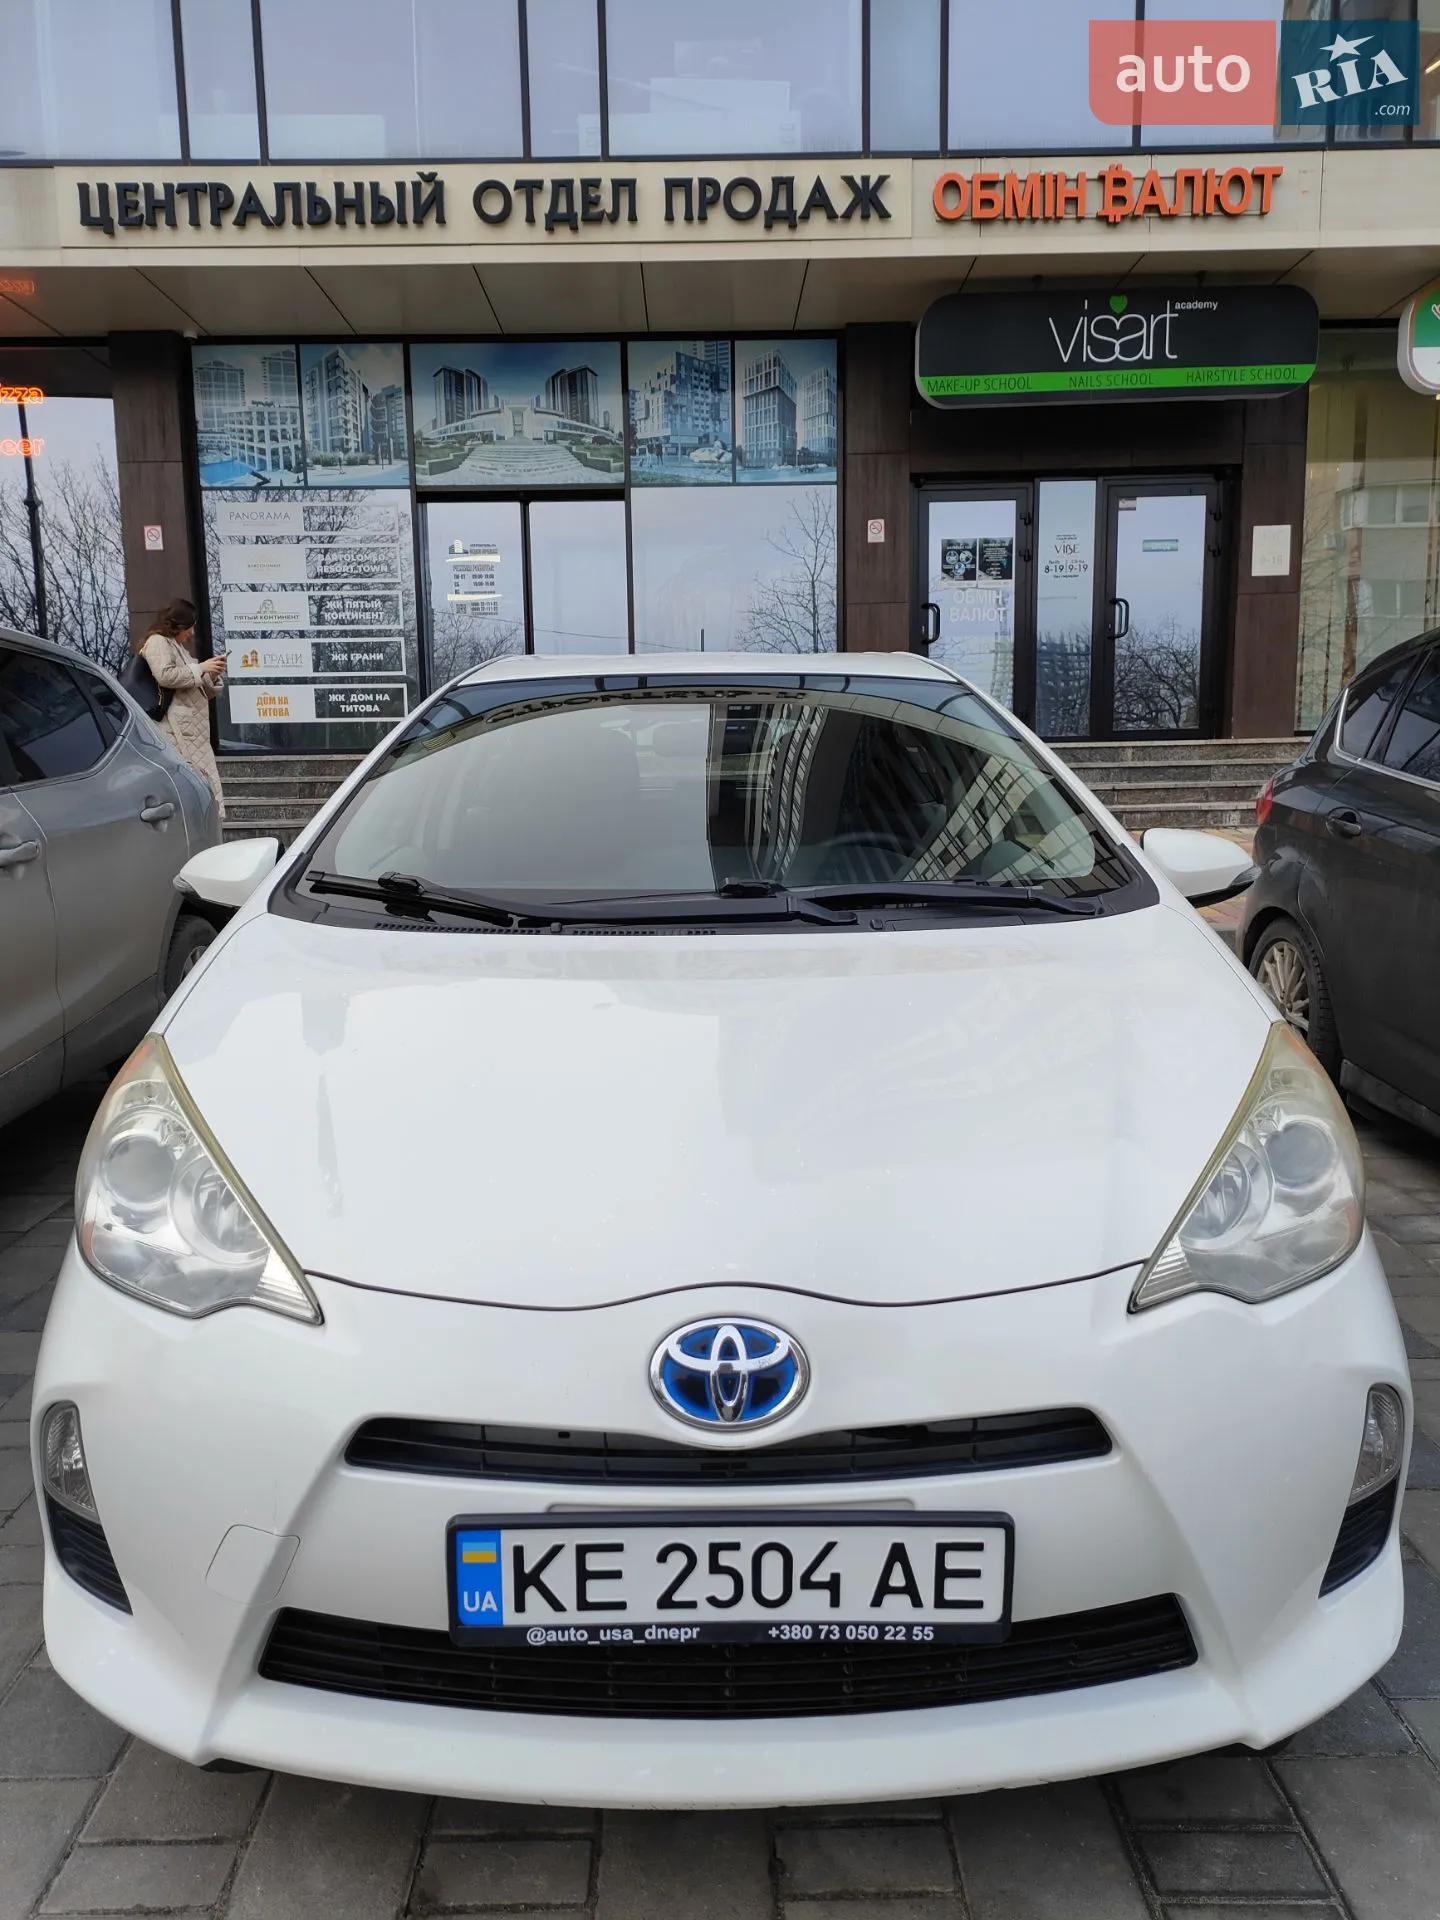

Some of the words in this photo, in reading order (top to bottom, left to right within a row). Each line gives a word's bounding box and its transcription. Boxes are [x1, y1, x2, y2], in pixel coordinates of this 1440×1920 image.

[933, 168, 1087, 221] ОБМІН
[77, 171, 446, 235] ЦЕНТРАЛЬНЫЙ
[472, 178, 638, 231] ОТДЕЛ
[664, 174, 891, 229] ПРОДАЖ
[1174, 300, 1218, 311] academy
[1069, 374, 1101, 389] NAILS
[1105, 373, 1155, 387] SCHOOL
[1186, 370, 1246, 383] HAIRSTYLE
[1249, 367, 1298, 381] SCHOOL
[927, 376, 981, 393] MAKE-UP
[984, 375, 1032, 391] SCHOOL
[0, 438, 45, 456] eer
[229, 511, 291, 521] PANORAMA
[317, 565, 354, 573] RESORT
[357, 564, 388, 573] TOWN
[1044, 564, 1064, 574] 8-19
[1068, 563, 1088, 573] 9-19
[953, 589, 1003, 605] ОБМІН
[326, 600, 342, 609] ЖК
[345, 599, 382, 608] ПЯТЫЙ
[324, 611, 384, 620] КОНТИНЕНТ
[949, 607, 1006, 622] ВАЛЮТ
[264, 653, 303, 665] ГРАНИ
[331, 653, 348, 661] ЖК
[350, 653, 384, 661] ГРАНИ
[256, 696, 275, 707] ДОМ
[278, 696, 289, 706] НА
[329, 694, 345, 702] ЖК
[350, 693, 373, 702] ДОМ
[376, 693, 391, 701] НА
[257, 707, 290, 717] ТИТОВА
[340, 704, 380, 712] ТИТОВА
[512, 1542, 627, 1613] KE
[656, 1540, 841, 1610] 2504
[869, 1541, 985, 1610] AE
[463, 1591, 498, 1612] UA
[526, 1625, 700, 1644] @auto_usa_dnepr
[768, 1625, 813, 1641] +380
[819, 1625, 840, 1641] 73
[845, 1624, 880, 1641] 050
[884, 1625, 907, 1641] 22
[911, 1625, 934, 1641] 55
